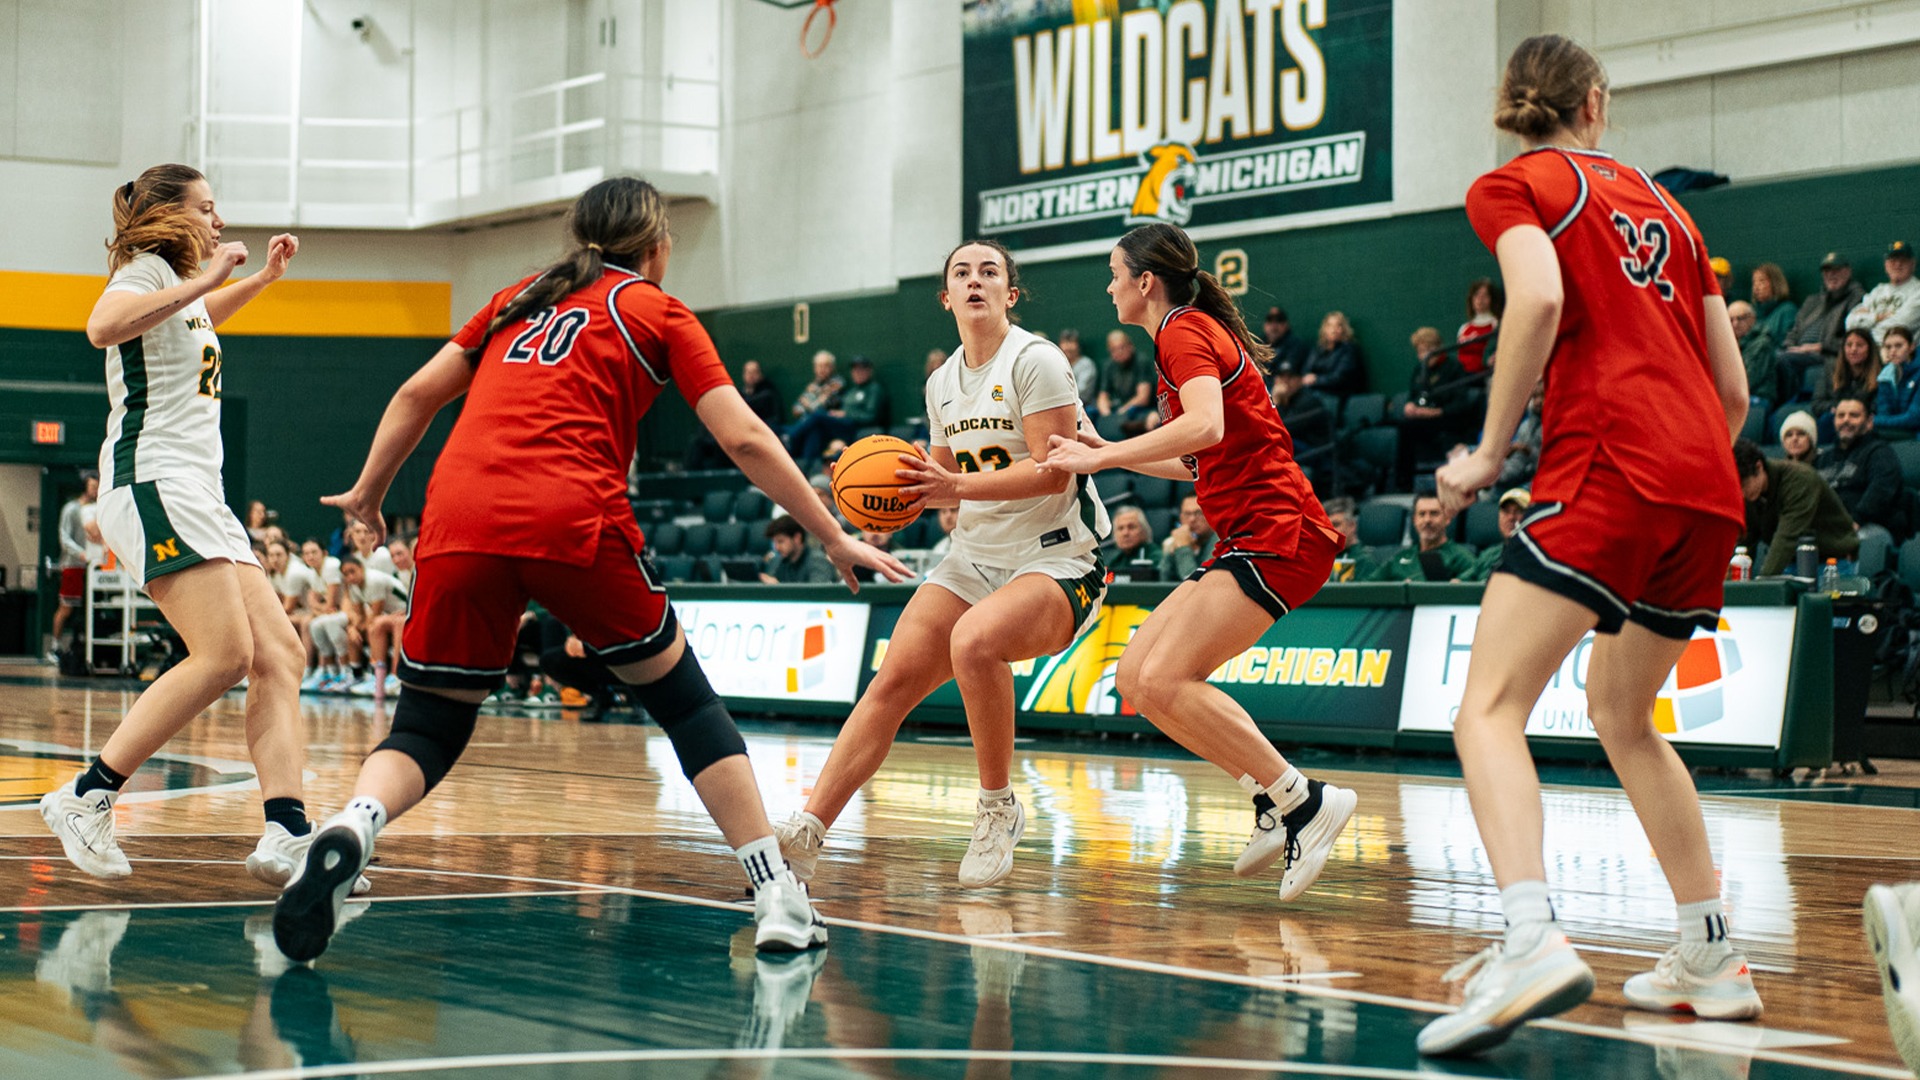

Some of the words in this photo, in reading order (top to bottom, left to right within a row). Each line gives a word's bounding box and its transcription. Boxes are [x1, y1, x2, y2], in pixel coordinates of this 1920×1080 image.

[1013, 0, 1327, 174] WILDCATS
[983, 174, 1140, 227] NORTHERN
[1194, 141, 1359, 196] MICHIGAN
[1216, 248, 1248, 296] 2
[1610, 208, 1674, 302] 32
[502, 305, 590, 366] 20
[37, 421, 60, 443] EXIT
[153, 538, 180, 562] N
